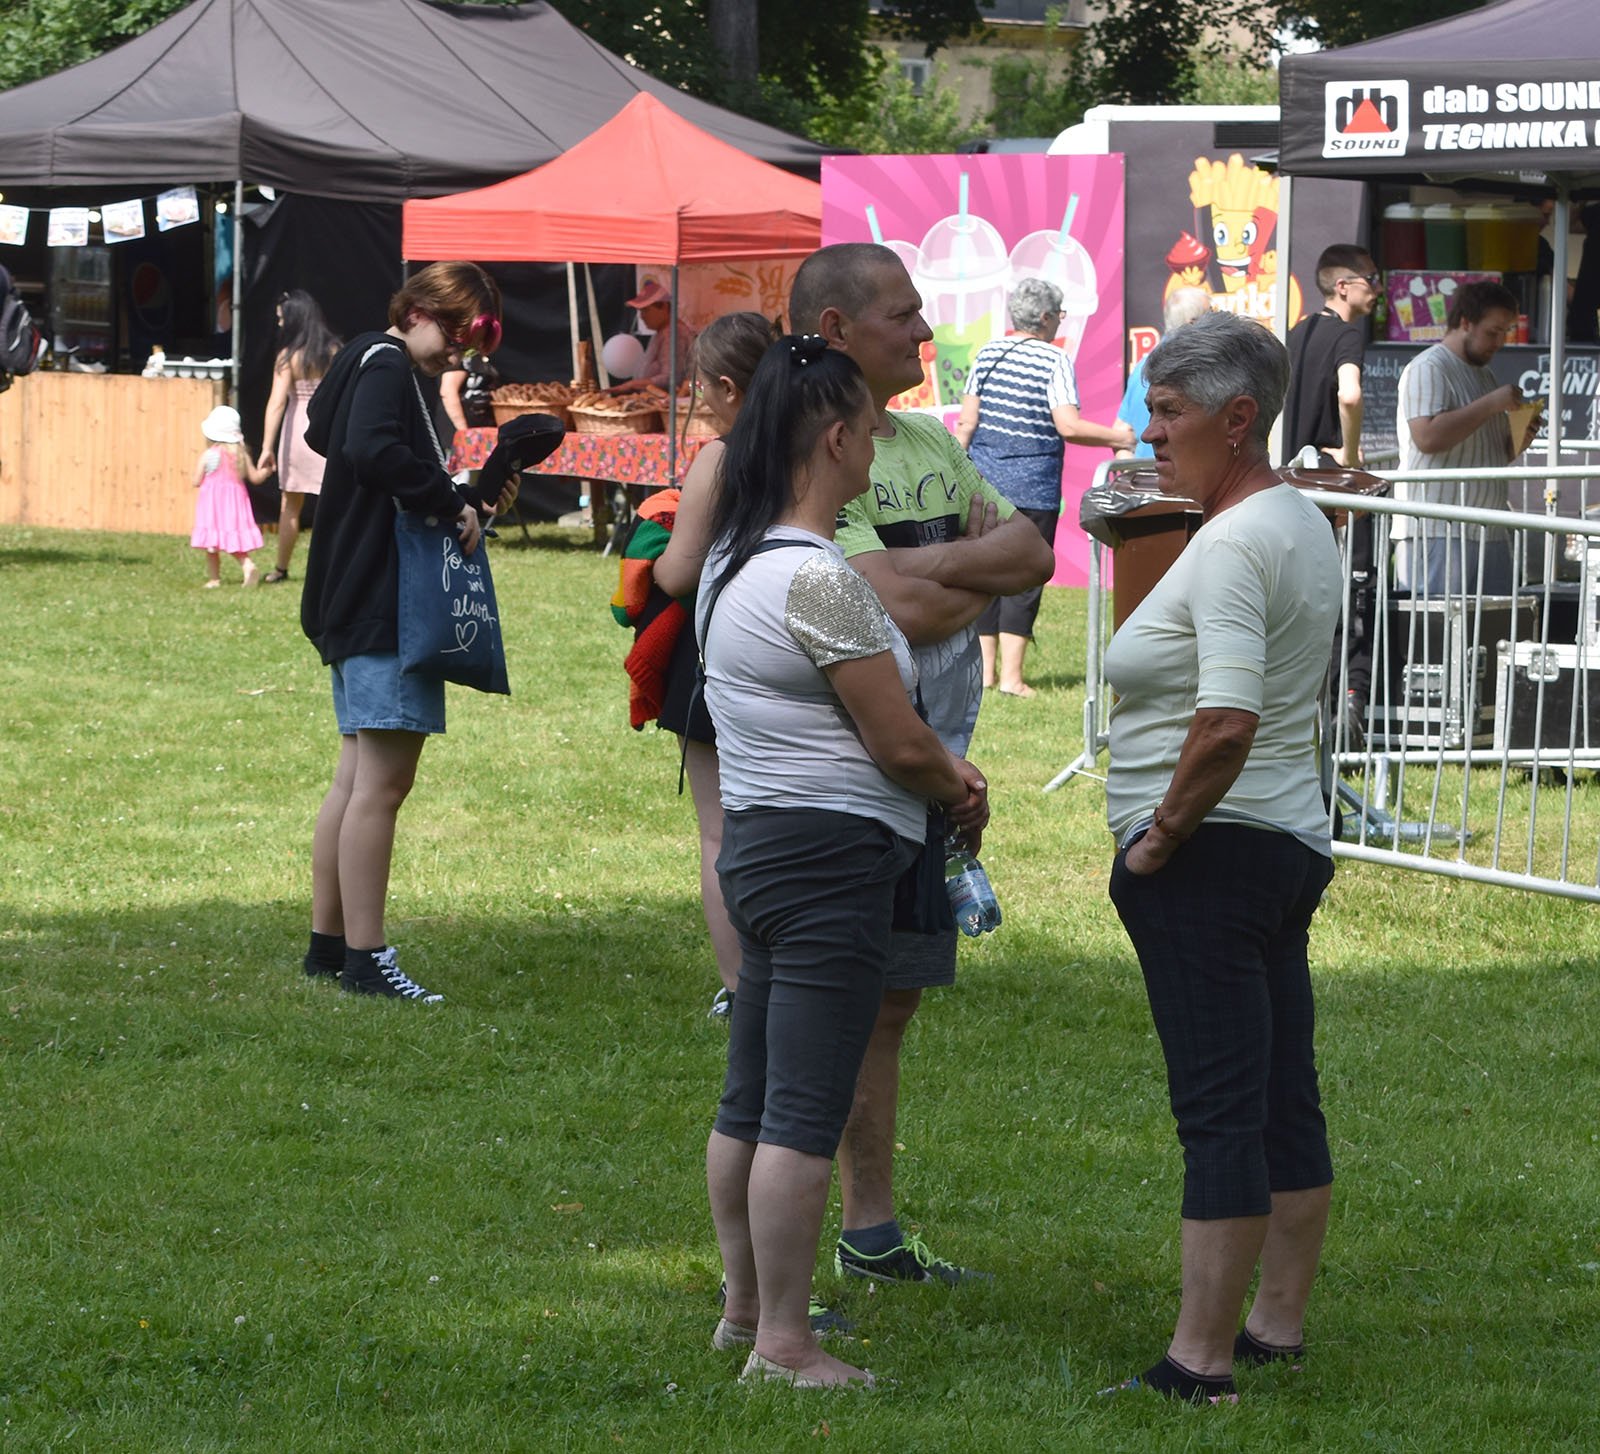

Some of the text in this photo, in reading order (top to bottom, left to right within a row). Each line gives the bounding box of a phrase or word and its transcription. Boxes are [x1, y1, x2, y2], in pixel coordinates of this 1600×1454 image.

[1423, 85, 1489, 114] dab
[1330, 139, 1400, 151] SOUND
[1422, 120, 1588, 150] TECHNIKA
